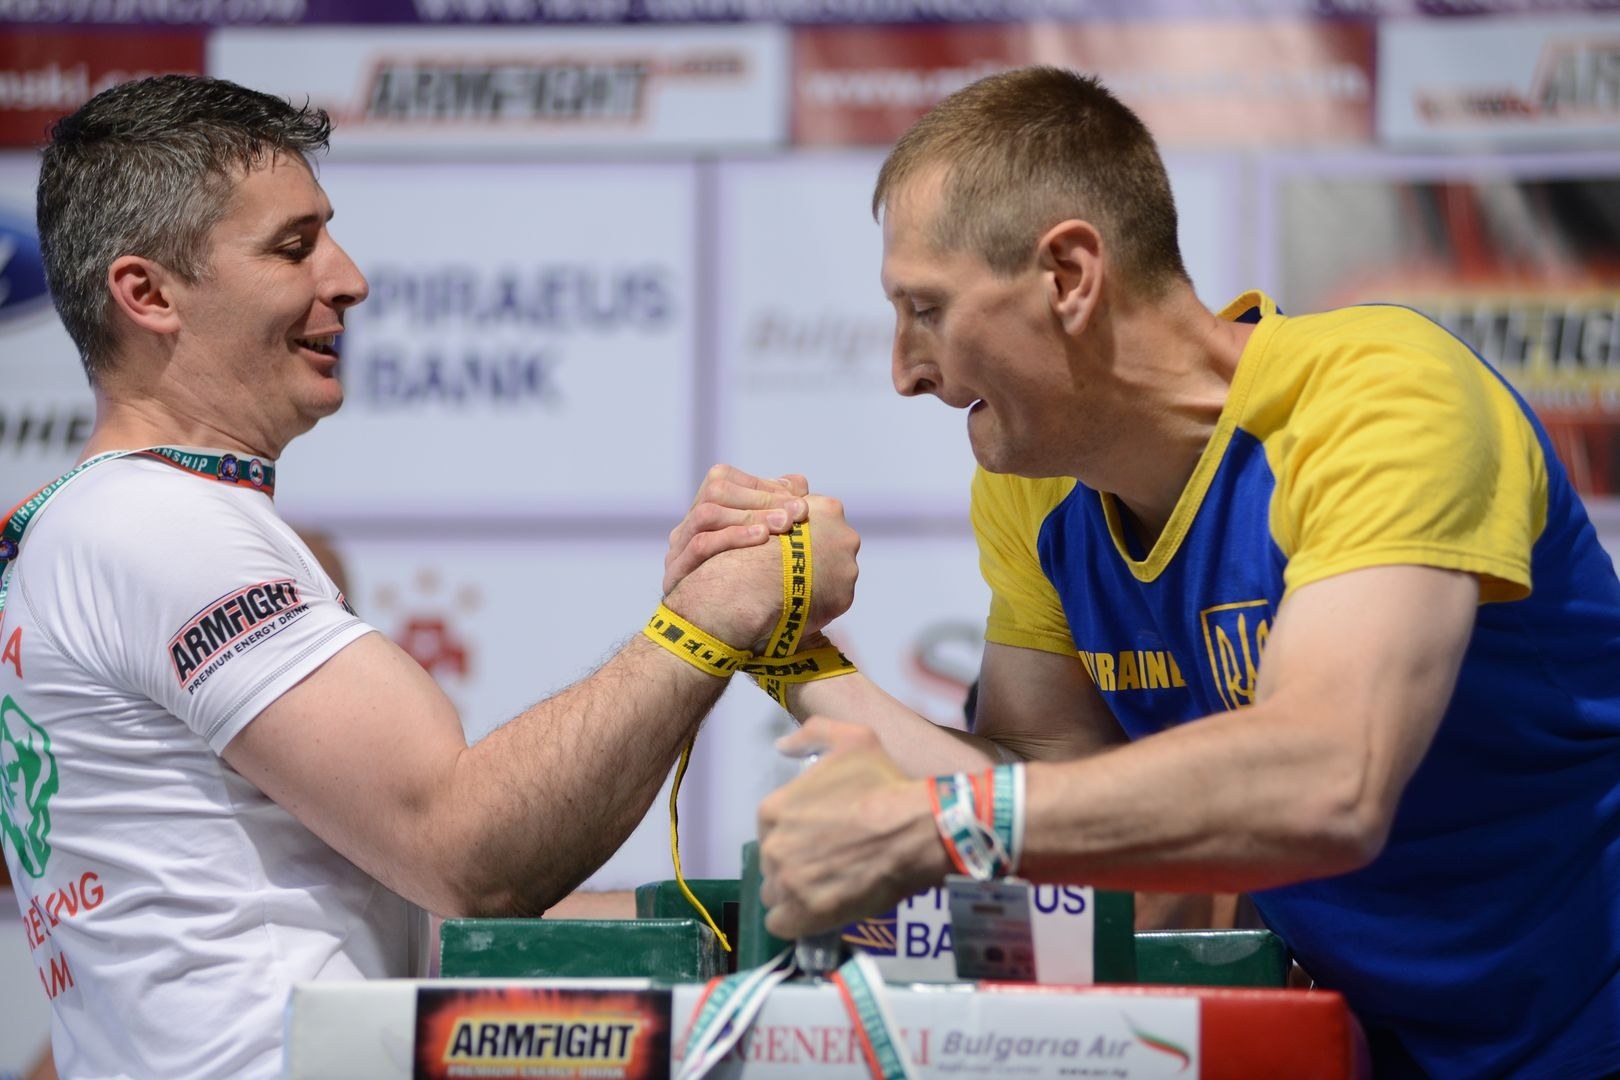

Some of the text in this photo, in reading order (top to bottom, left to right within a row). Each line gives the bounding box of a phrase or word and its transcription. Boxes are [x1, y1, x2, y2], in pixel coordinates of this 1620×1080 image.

[366, 348, 556, 408] BANK
[171, 582, 300, 683] ARMFIGHT
[188, 651, 234, 695] PREMIUM
[235, 621, 276, 654] ENERGY
[279, 602, 310, 626] DRINK
[450, 1022, 635, 1057] ARMFIGHT
